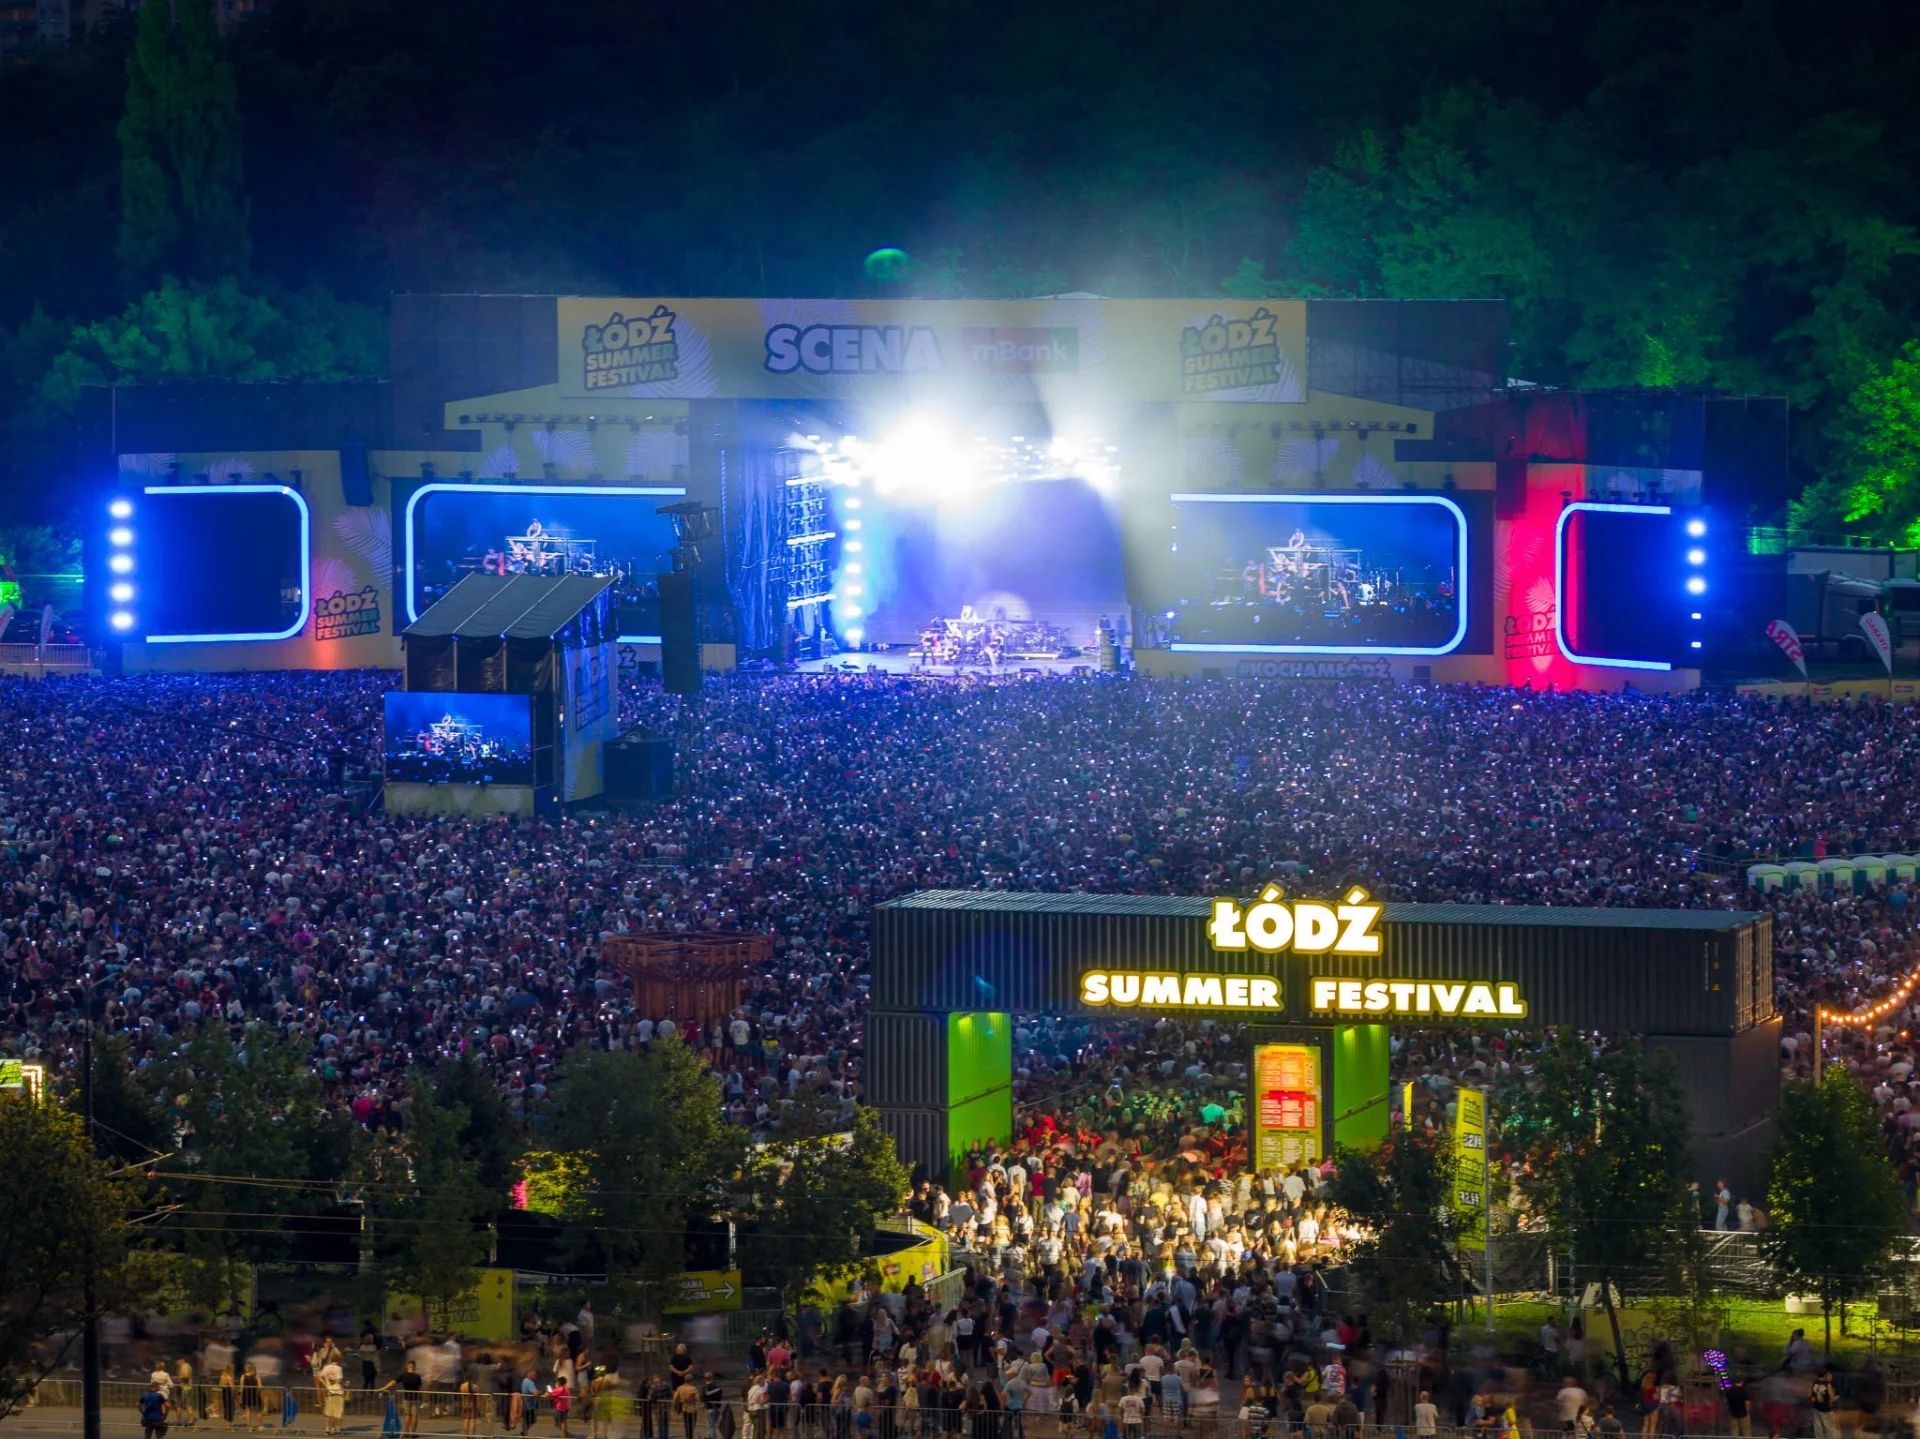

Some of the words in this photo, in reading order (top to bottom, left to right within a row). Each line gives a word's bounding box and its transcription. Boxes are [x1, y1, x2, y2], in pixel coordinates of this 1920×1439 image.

[583, 305, 676, 353] ŁÓDŹ
[1181, 307, 1277, 357] ŁÓDŹ
[586, 344, 677, 370] SUMMER
[765, 323, 942, 374] SCENA
[972, 340, 1068, 362] mBank
[586, 362, 677, 388] FESTIVAL
[315, 586, 378, 617] ŁÓDŹ
[317, 608, 378, 627] SUMMER
[317, 620, 378, 640] FESTIVAL
[1210, 886, 1380, 952] ŁÓDŹ
[1082, 973, 1281, 1008] SUMMER
[1314, 980, 1524, 1015] FESTIVAL
